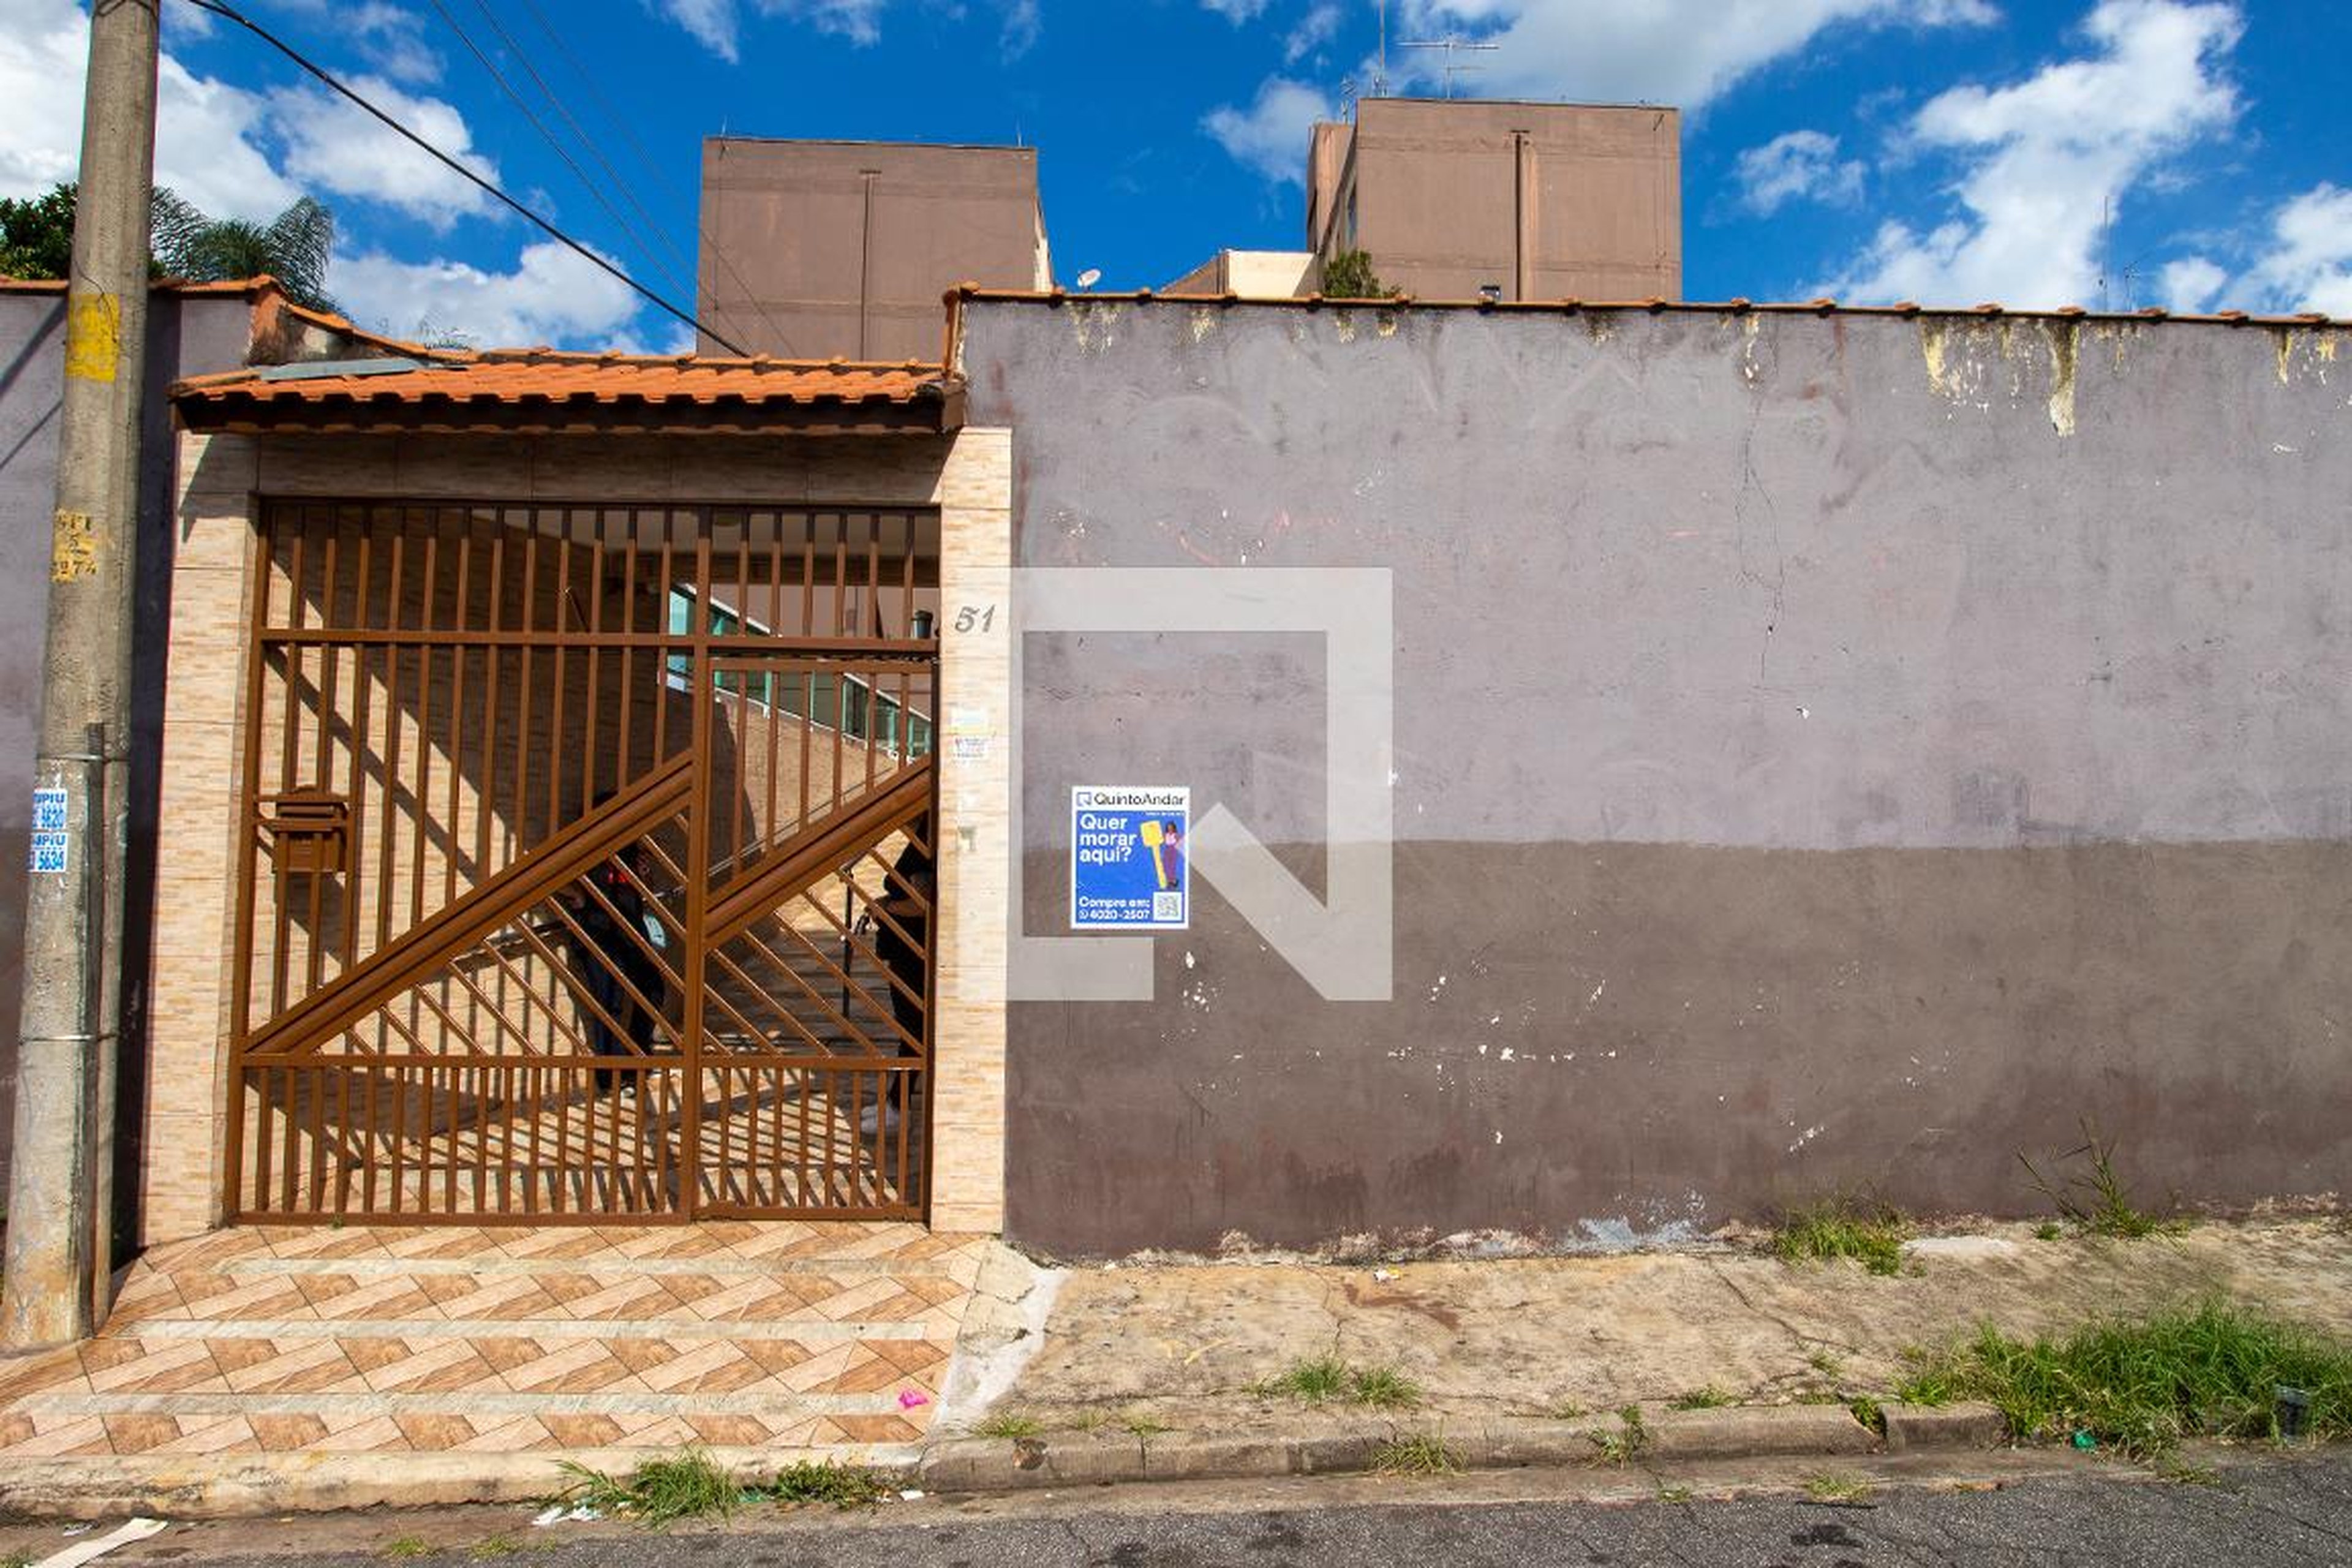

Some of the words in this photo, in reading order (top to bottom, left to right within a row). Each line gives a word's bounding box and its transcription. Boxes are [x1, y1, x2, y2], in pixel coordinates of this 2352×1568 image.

[954, 604, 995, 633] 51
[1094, 793, 1185, 805] QuintoAndar
[1080, 813, 1128, 830] Quer
[1079, 834, 1137, 846] morar
[1079, 846, 1131, 865] aqui?
